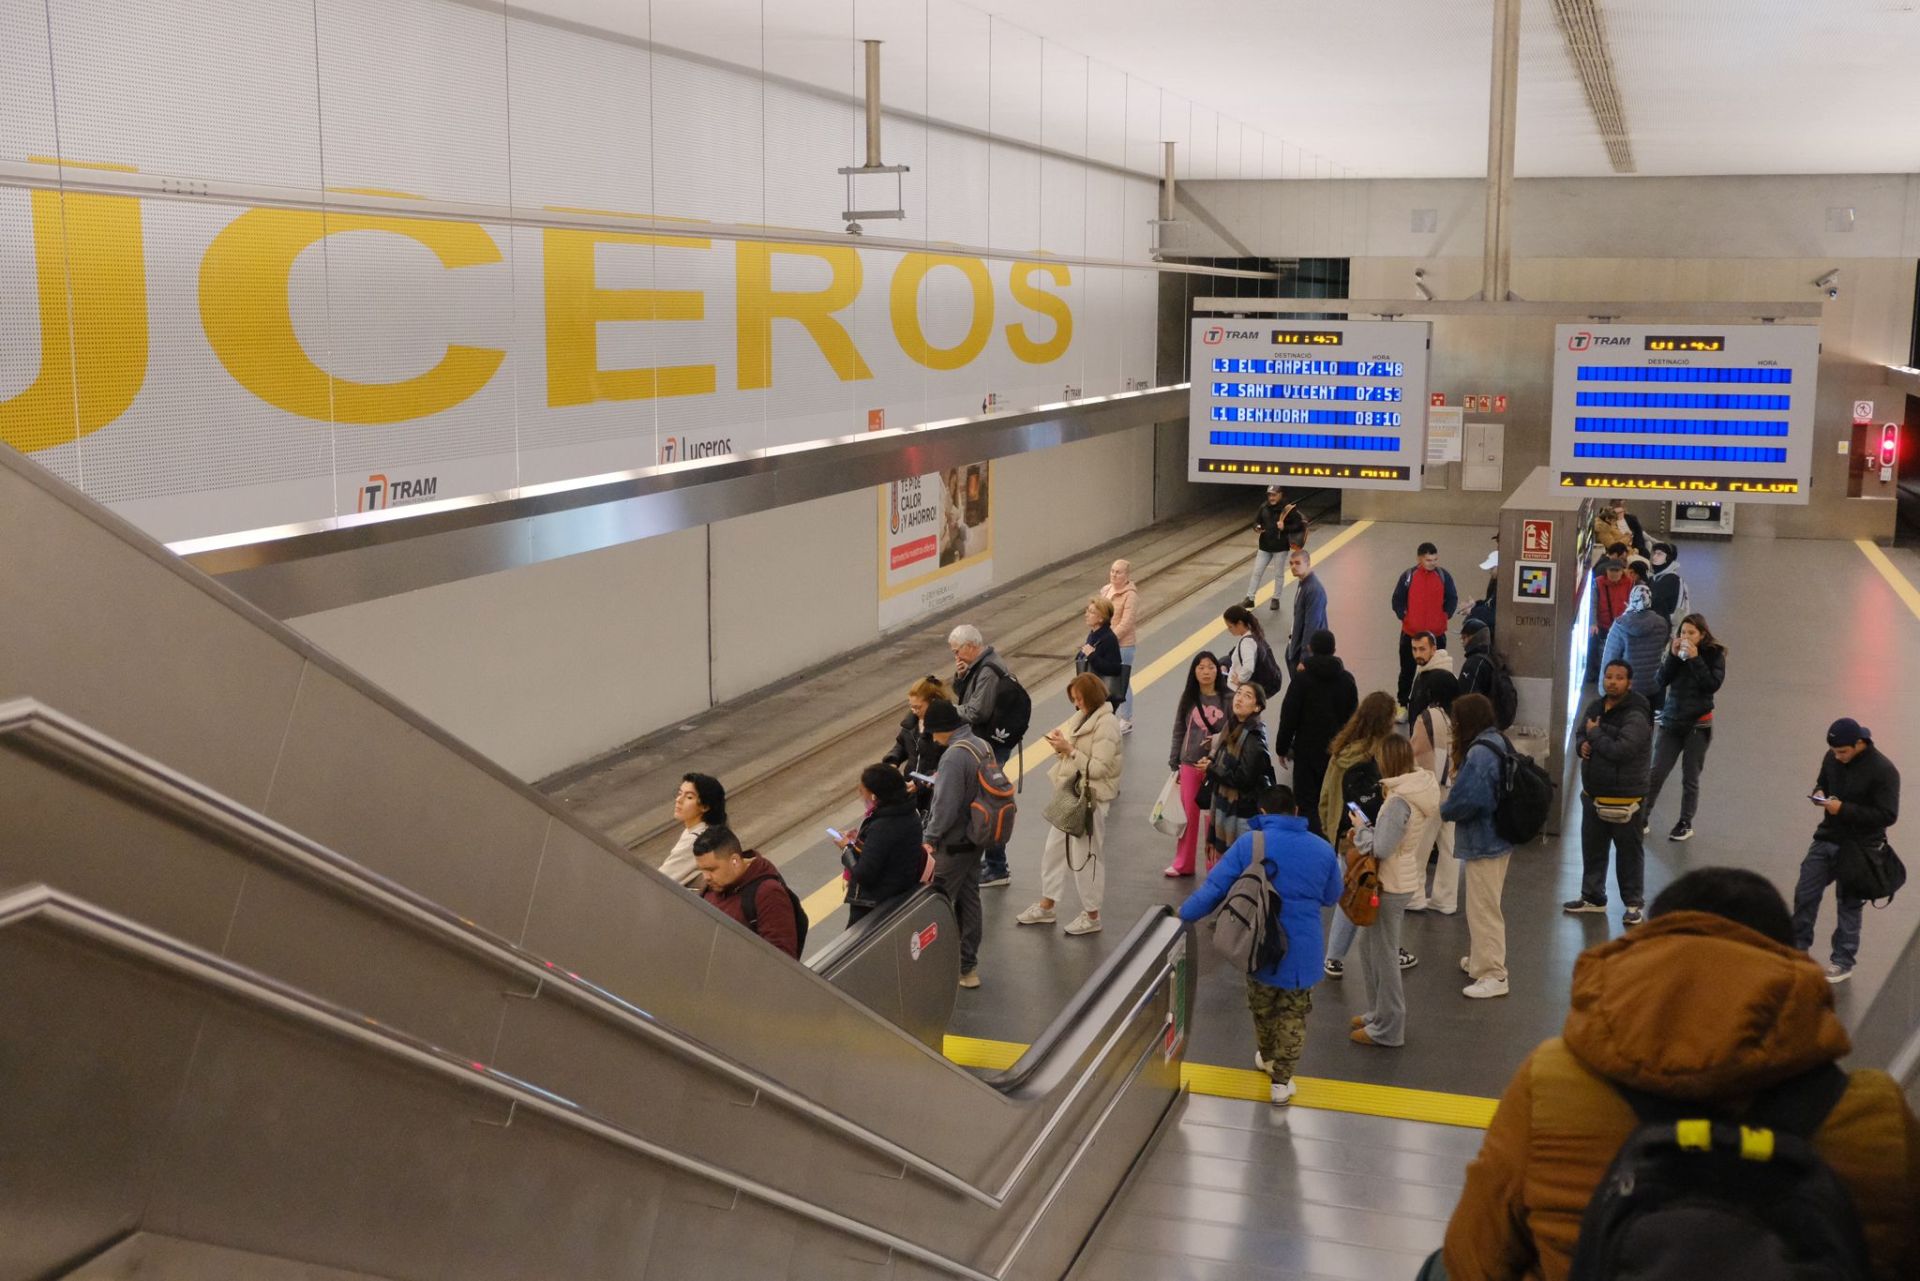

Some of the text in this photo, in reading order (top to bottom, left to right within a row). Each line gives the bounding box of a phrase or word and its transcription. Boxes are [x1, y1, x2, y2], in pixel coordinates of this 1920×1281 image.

[1225, 330, 1260, 341] TRAM
[1593, 336, 1632, 346] TRAM
[1212, 359, 1403, 377] L3 EL CAMPELLO 07:48
[1211, 383, 1402, 401] L2 SANT VICENT 07:53
[1211, 407, 1401, 426] L1 BENIDORM 08:10
[390, 477, 437, 500] TRAM
[901, 492, 922, 511] CALOR
[908, 505, 937, 528] AHORRO!
